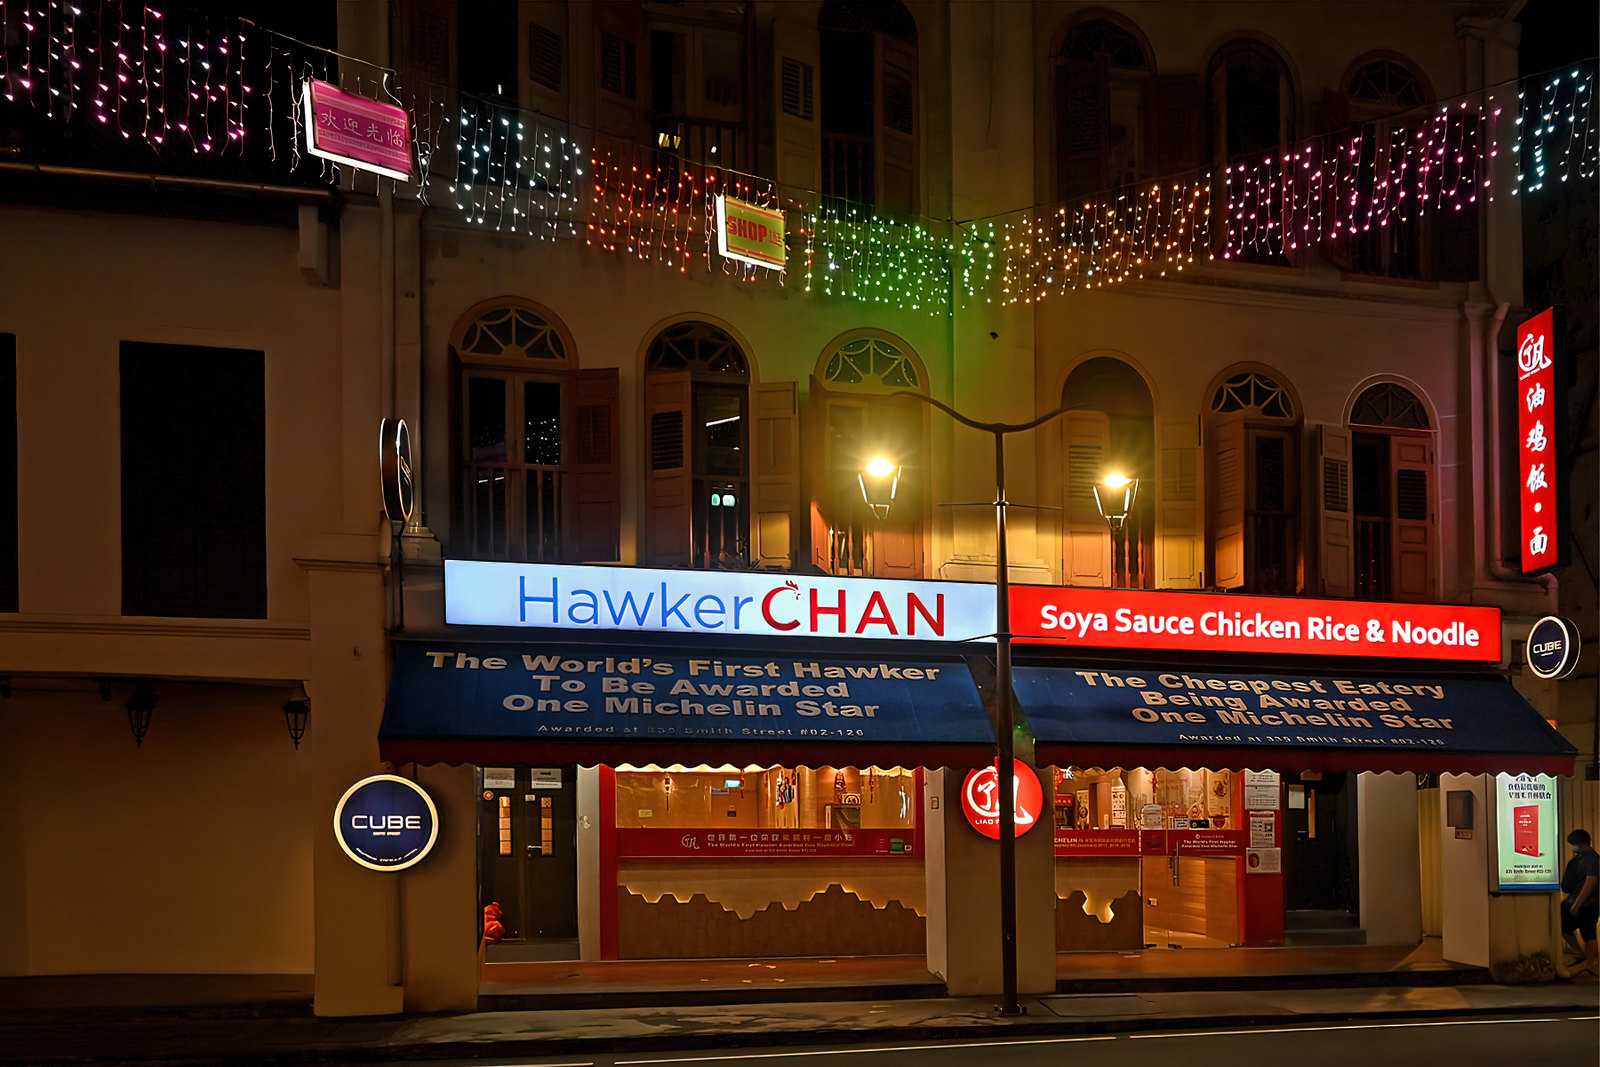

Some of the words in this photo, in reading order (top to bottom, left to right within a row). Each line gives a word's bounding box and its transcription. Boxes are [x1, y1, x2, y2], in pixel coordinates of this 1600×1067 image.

[320, 109, 405, 148] 欢迎光临
[727, 215, 768, 244] SHOP
[1040, 604, 1109, 638] Soya
[1114, 607, 1195, 636] Sauce
[1199, 610, 1301, 640] Chicken
[1307, 615, 1360, 643] Rice
[1365, 618, 1386, 644] &
[1391, 620, 1480, 647] Noodle
[1533, 640, 1562, 654] CUBE
[426, 651, 508, 670] The
[522, 654, 674, 676] World's
[689, 659, 781, 678] First
[793, 662, 941, 681] Hawker
[533, 675, 586, 693] To
[602, 677, 656, 695] Be
[669, 679, 849, 698] Awarded
[1074, 671, 1148, 689] The
[1157, 673, 1328, 695] Cheapest
[1332, 679, 1446, 701] Eatery
[502, 694, 590, 713] One
[605, 697, 782, 717] Michelin
[796, 699, 880, 719] Star
[1139, 690, 1249, 712] Being
[1259, 693, 1413, 713] Awarded
[1131, 707, 1208, 724] One
[1215, 710, 1373, 729] Michelin
[1380, 714, 1454, 730] Star
[538, 725, 615, 734] Awarded
[623, 726, 640, 735] at
[684, 726, 734, 736] Smith
[742, 727, 794, 737] Street
[1178, 733, 1242, 743] Awarded
[351, 814, 422, 830] CUBE
